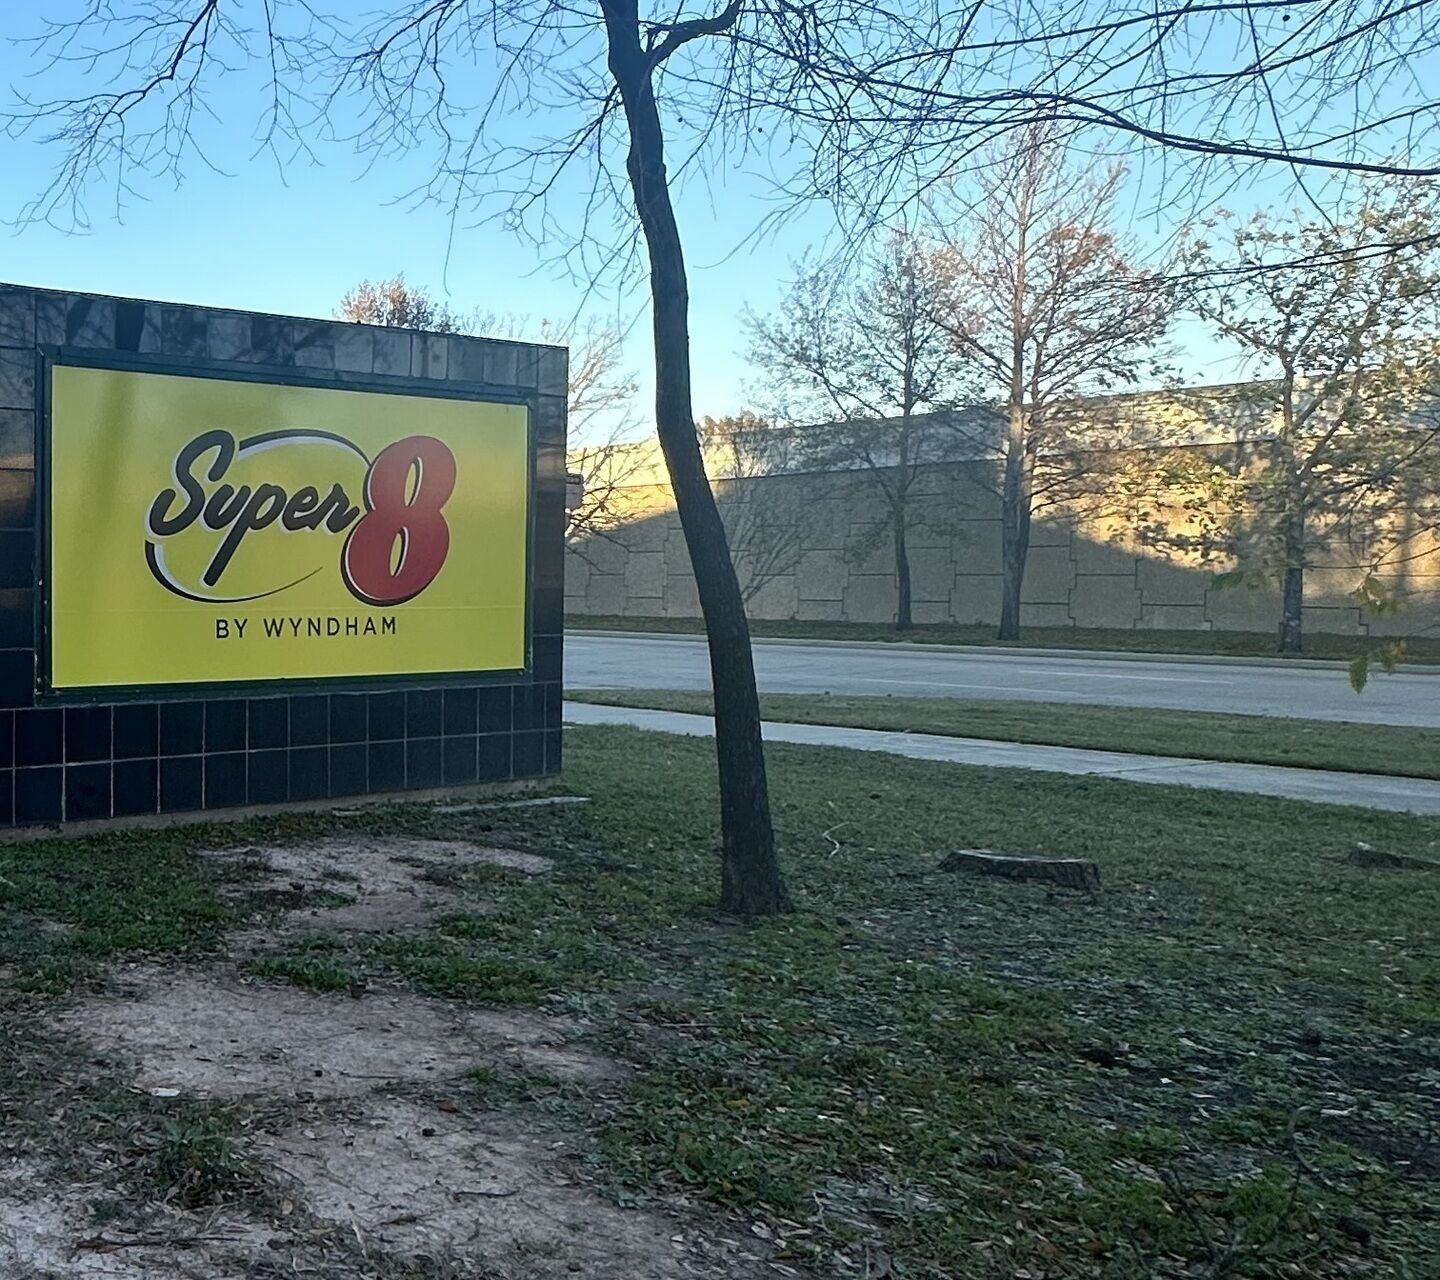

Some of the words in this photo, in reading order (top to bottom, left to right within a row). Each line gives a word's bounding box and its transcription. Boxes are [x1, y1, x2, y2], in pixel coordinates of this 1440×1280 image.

[148, 429, 360, 587] Super
[341, 435, 457, 607] 8
[216, 618, 248, 639] BY
[263, 616, 396, 638] WYNDHAM
